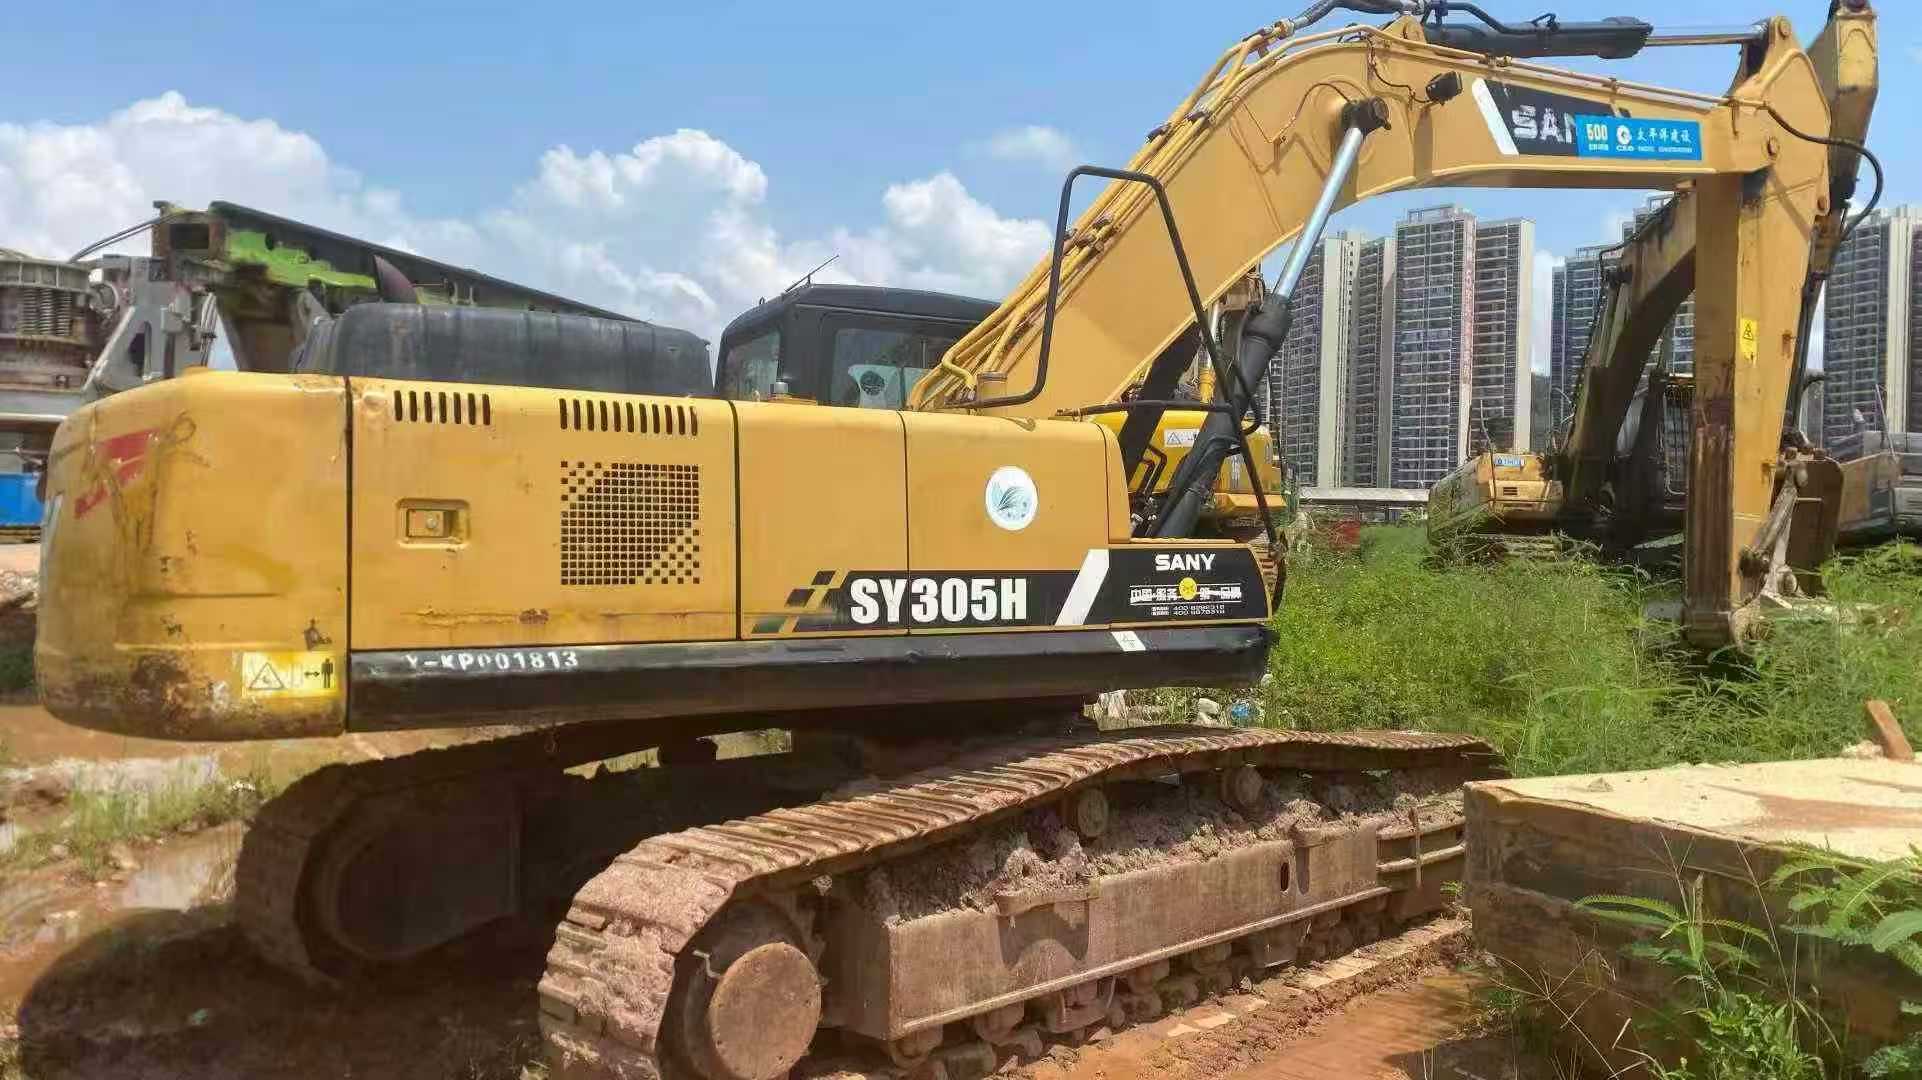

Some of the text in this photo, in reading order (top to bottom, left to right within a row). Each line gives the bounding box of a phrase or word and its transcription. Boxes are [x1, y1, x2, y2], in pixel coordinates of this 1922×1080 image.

[1512, 104, 1577, 144] SAN
[1155, 553, 1216, 571] SANY
[850, 578, 1027, 624] SY305H
